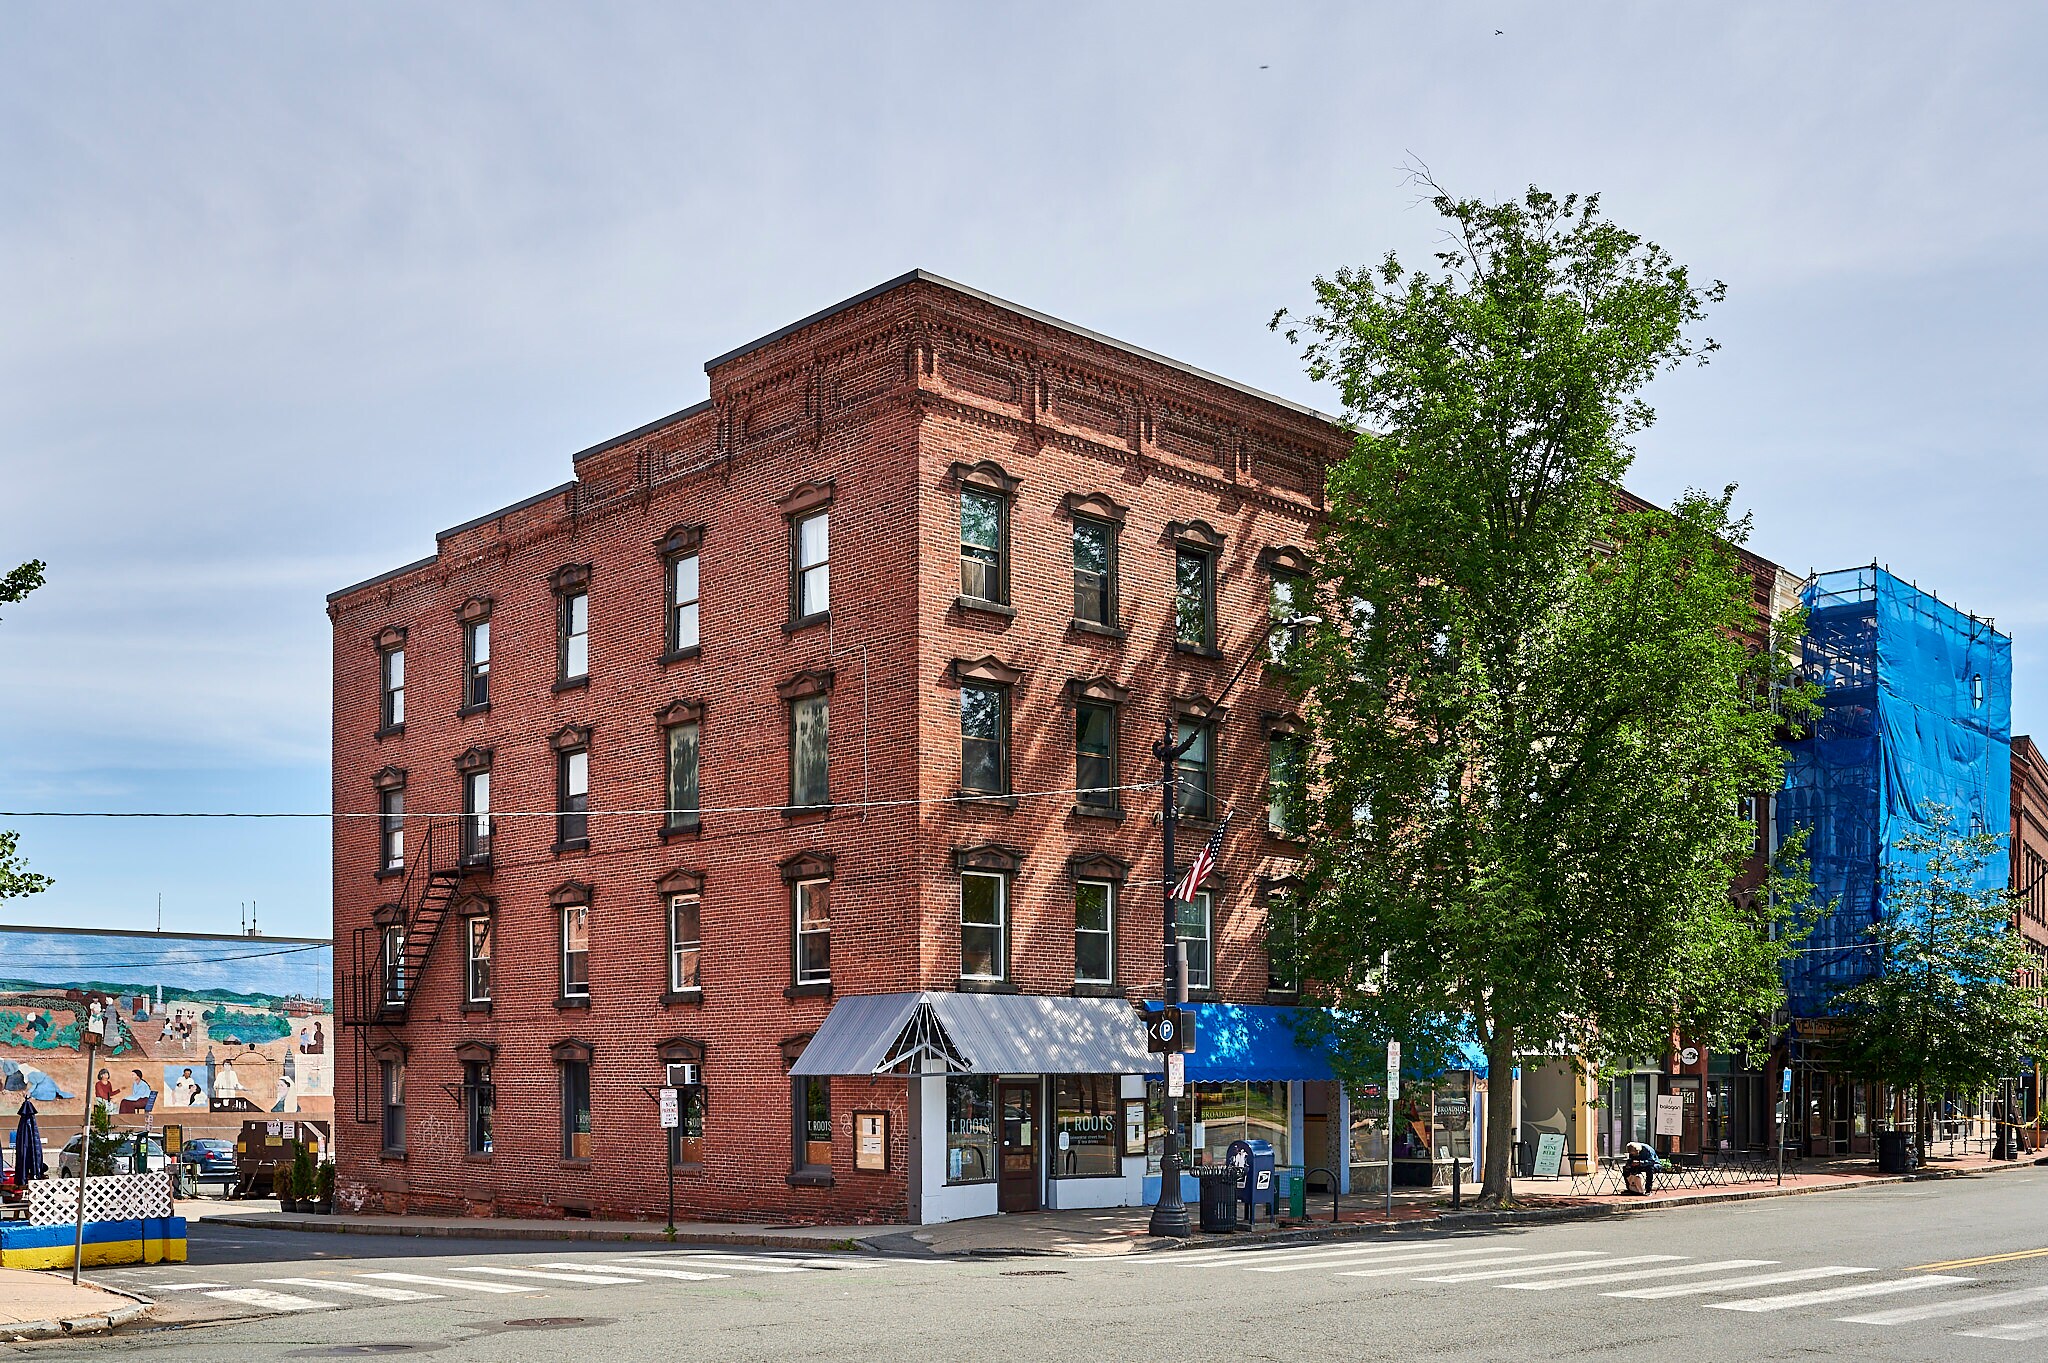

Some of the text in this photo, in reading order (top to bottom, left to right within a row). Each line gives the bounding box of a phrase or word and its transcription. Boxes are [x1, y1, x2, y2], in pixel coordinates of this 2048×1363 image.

[1163, 1024, 1169, 1037] P
[813, 1120, 832, 1131] ROOTS
[960, 1117, 990, 1135] ROOTS
[1062, 1115, 1113, 1131] T. ROOTS
